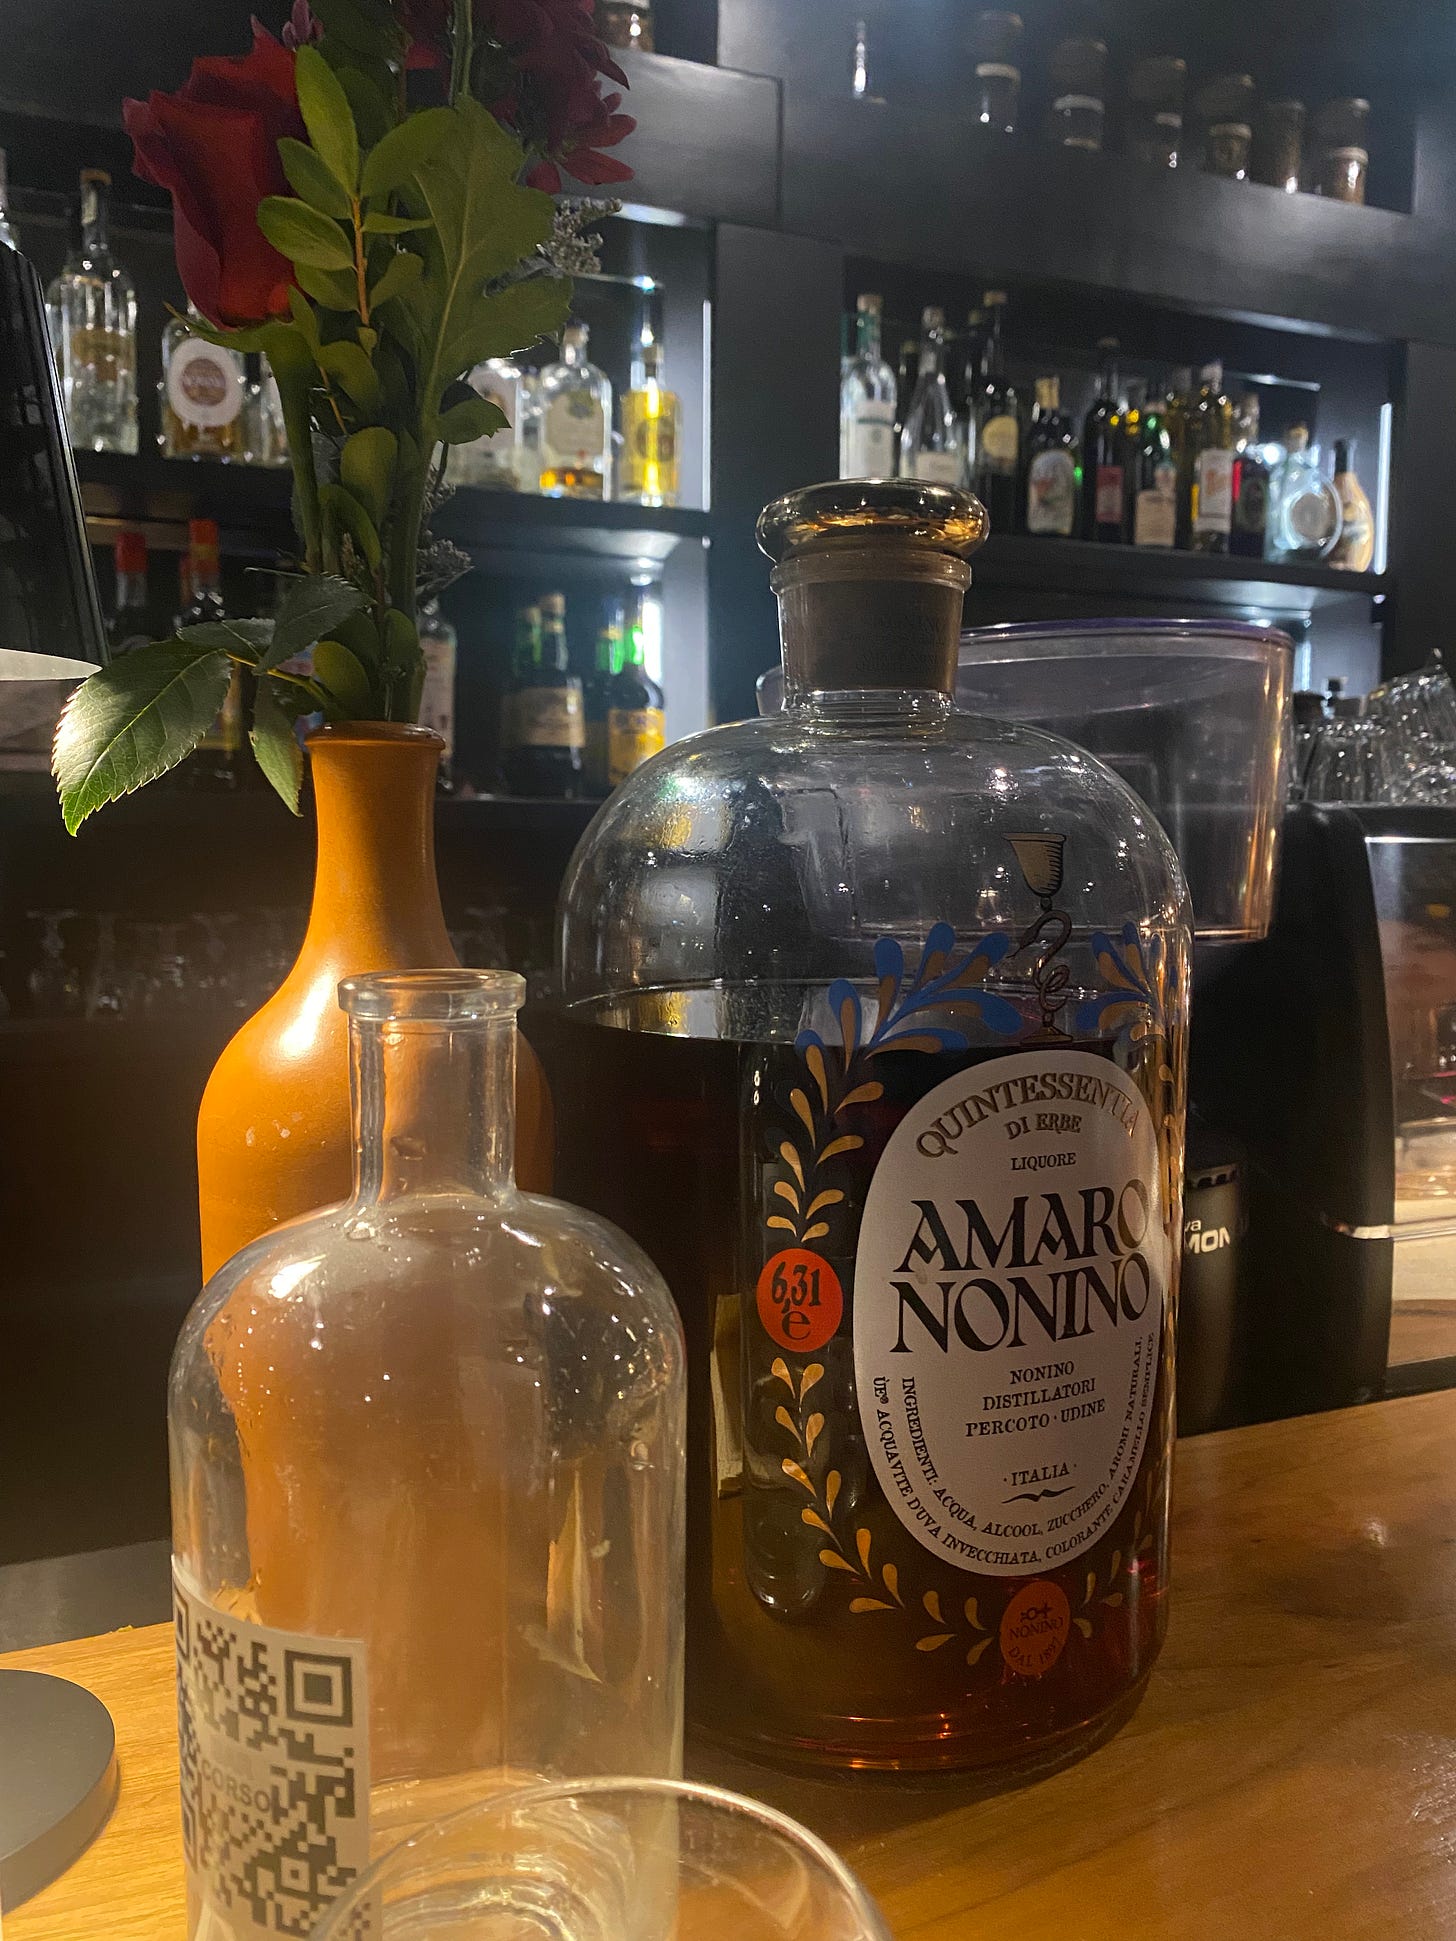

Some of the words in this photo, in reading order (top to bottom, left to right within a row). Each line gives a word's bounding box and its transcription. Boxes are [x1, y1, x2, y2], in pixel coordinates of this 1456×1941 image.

[1004, 1116, 1029, 1140] DI
[1035, 1112, 1083, 1134] ERBE
[1011, 1152, 1077, 1171] LIQUORE
[893, 1179, 1148, 1272] AMARO
[889, 1252, 1150, 1353] NONINO
[1010, 1361, 1075, 1385] NONINO
[982, 1378, 1096, 1411] DISTILLATORI
[966, 1413, 1050, 1437] PERCOTO
[1060, 1398, 1106, 1424] UDINE
[876, 1409, 914, 1498] ACQUAVITE
[1045, 1503, 1114, 1560] COLORANTE
[1011, 1462, 1071, 1486] ITALIA
[933, 1488, 978, 1531] ACQUA,
[981, 1521, 1044, 1538] ALCOOL,
[201, 1759, 271, 1813] CORSO
